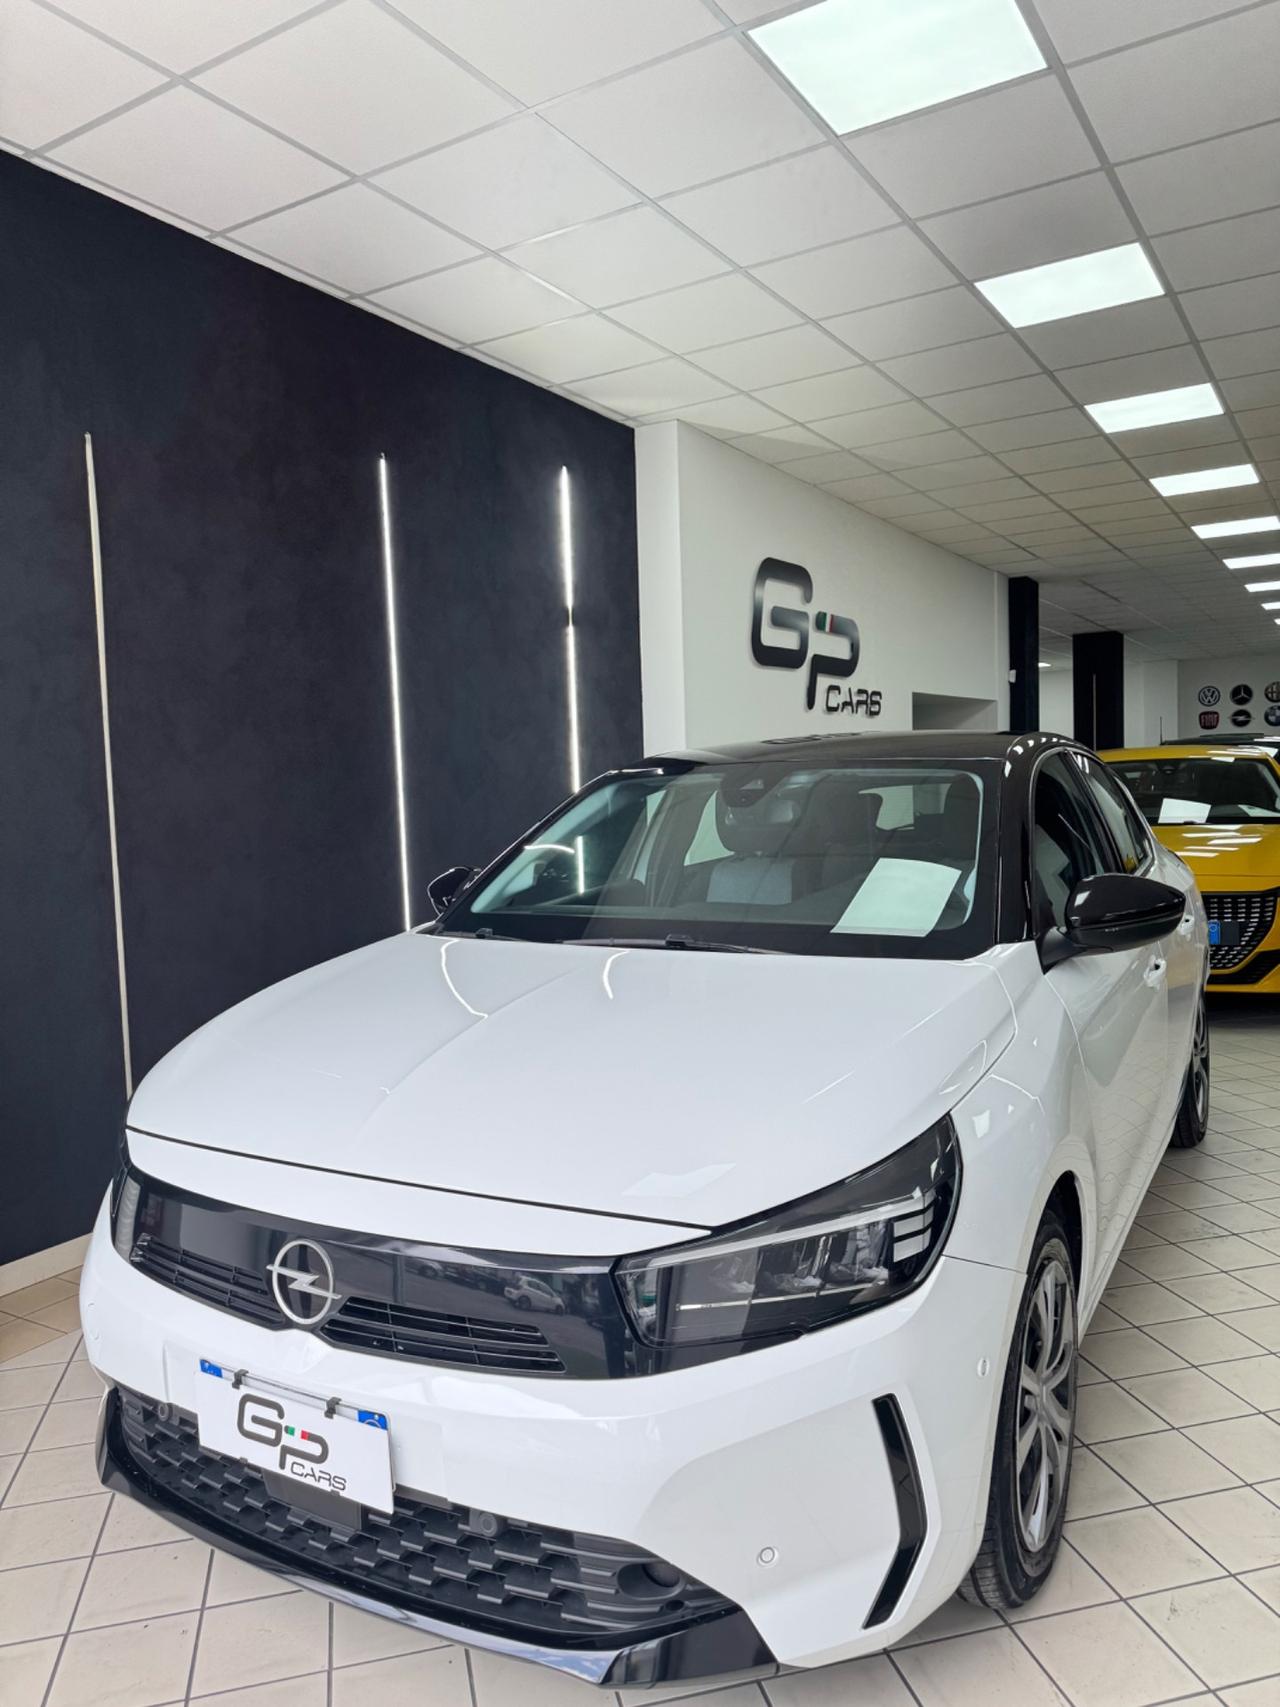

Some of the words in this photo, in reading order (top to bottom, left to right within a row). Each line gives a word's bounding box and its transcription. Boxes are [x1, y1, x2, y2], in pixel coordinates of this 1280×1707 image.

[751, 557, 860, 710] GP
[825, 684, 882, 716] CARS
[237, 1393, 329, 1470] GP
[290, 1461, 346, 1491] CARS
